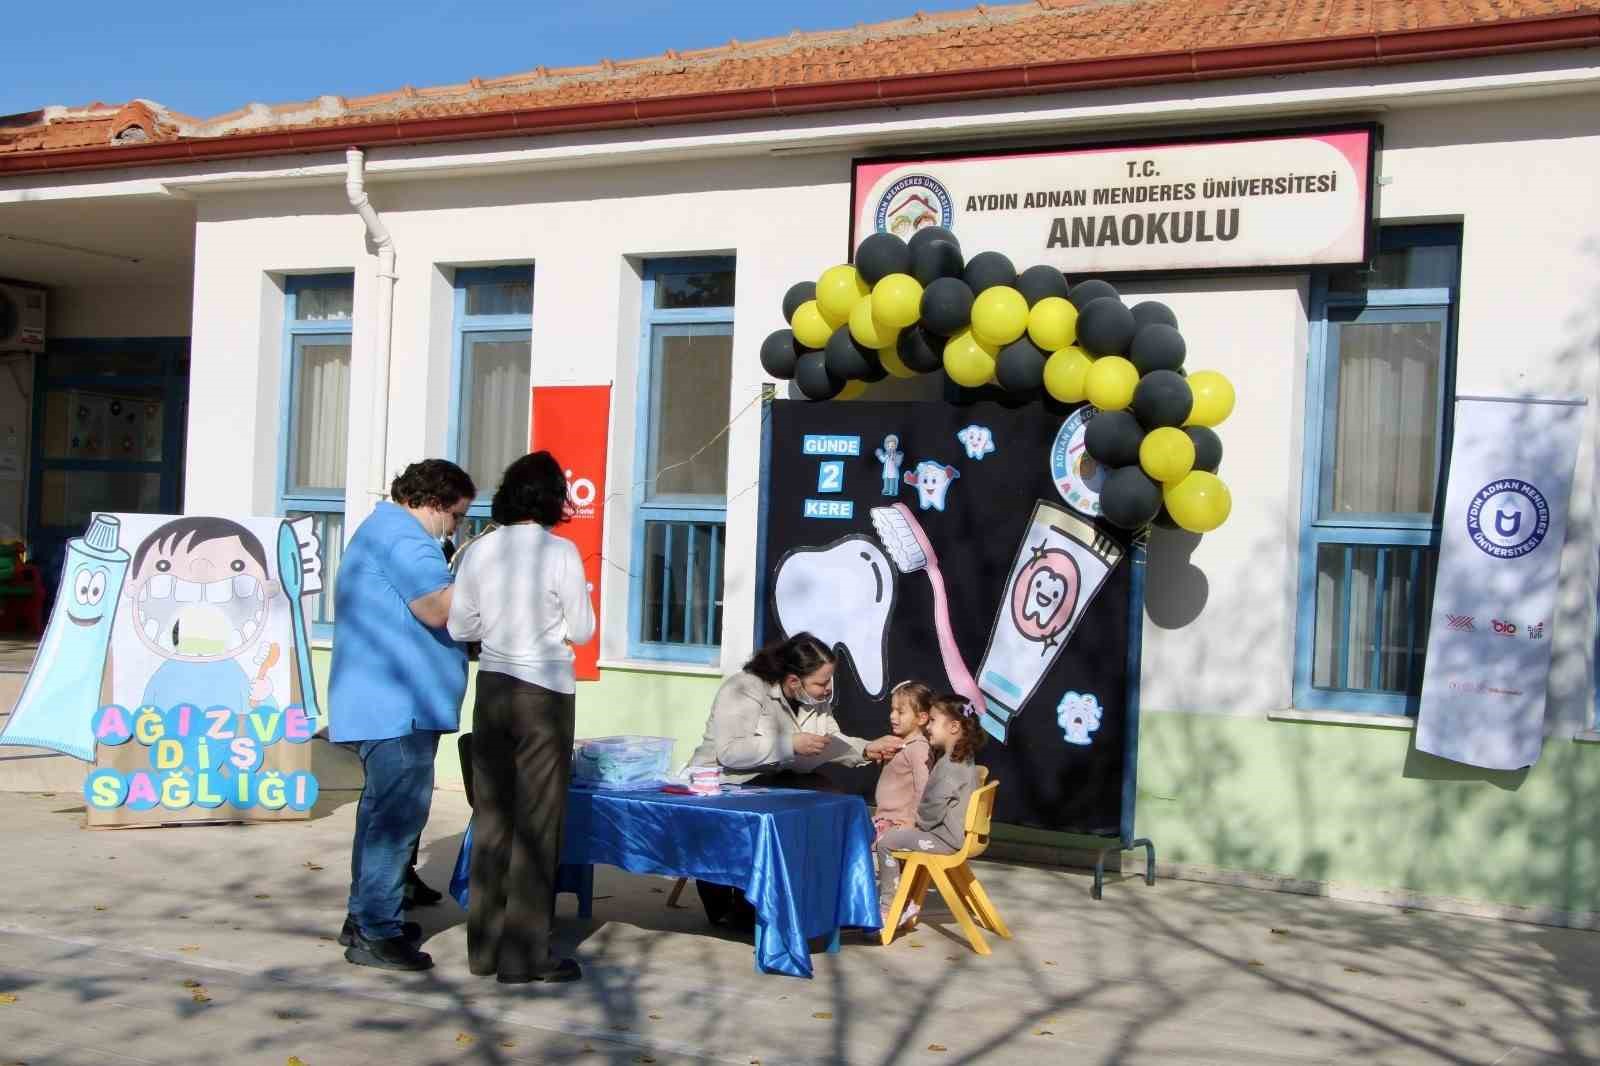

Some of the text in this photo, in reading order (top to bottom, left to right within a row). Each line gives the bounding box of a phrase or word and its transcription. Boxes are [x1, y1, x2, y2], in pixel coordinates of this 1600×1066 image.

[1126, 160, 1160, 178] T.C.
[965, 170, 1337, 212] AYDIN ADNAN MENDERES ÜNİVERSİTESİ
[1046, 208, 1240, 248] ANAOKULU
[821, 463, 841, 489] 2
[1482, 481, 1520, 499] ADNAN
[806, 502, 851, 516] KERE
[250, 708, 311, 743] VE
